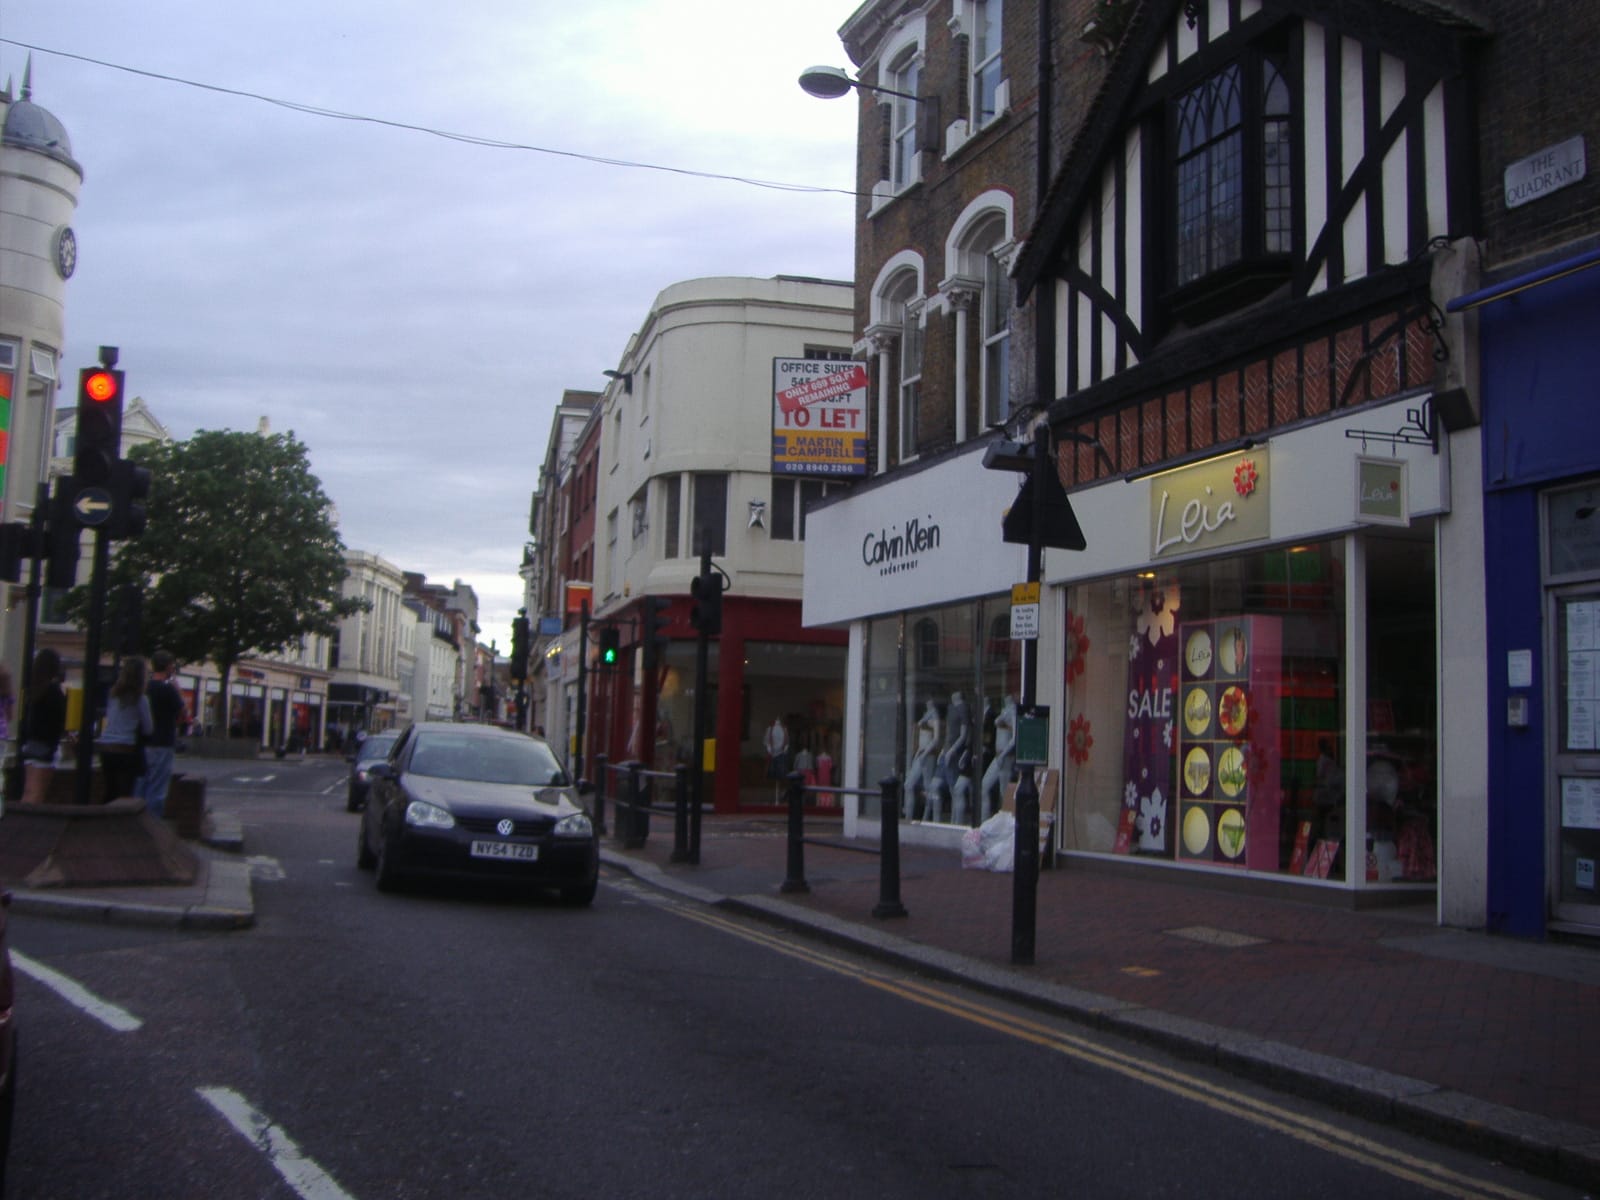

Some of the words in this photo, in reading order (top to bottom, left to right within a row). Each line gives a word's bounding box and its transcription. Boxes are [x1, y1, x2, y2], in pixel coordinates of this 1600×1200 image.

[1530, 151, 1555, 174] THE
[1507, 159, 1582, 204] QUADRANT
[781, 362, 820, 374] OFFICE
[823, 363, 861, 375] SUITE
[785, 385, 809, 399] ONLY
[798, 382, 850, 405] REMAINING
[783, 407, 810, 427] TO
[820, 408, 860, 429] LET
[788, 446, 850, 458] CAMPBELL
[796, 437, 844, 448] MARTIN
[785, 463, 803, 472] 020
[1155, 484, 1236, 555] Leia
[862, 525, 904, 566] Calvin
[905, 514, 940, 555] Klein
[880, 559, 918, 577] underwear
[1128, 688, 1172, 719] SALE
